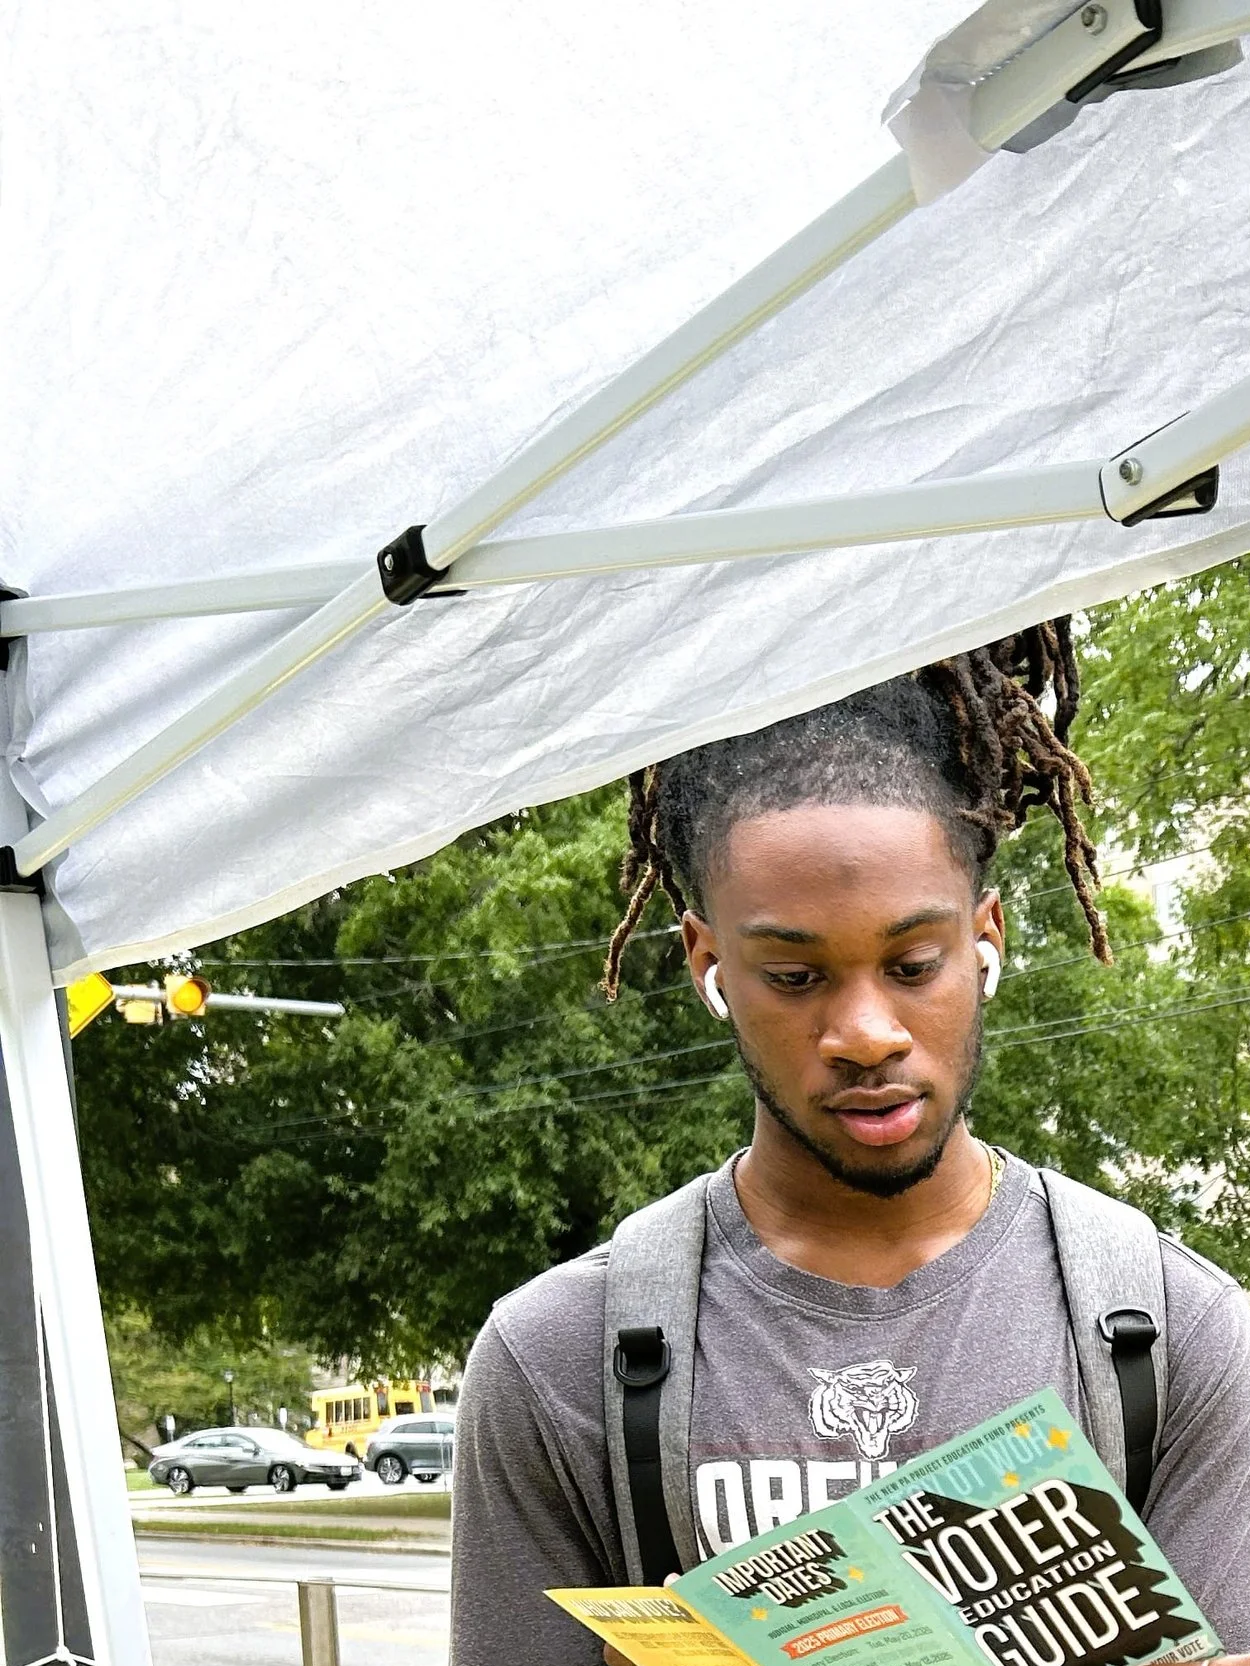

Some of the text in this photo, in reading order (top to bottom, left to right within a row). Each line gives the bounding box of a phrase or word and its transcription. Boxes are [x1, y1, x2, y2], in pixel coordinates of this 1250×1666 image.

[865, 1491, 881, 1505] THE
[882, 1484, 899, 1497] NEW
[899, 1475, 912, 1487] PA
[911, 1460, 943, 1482] PROJECT
[943, 1439, 985, 1464] EDUCATION
[985, 1426, 1006, 1443] FUND
[1006, 1404, 1046, 1432] PRESENTS
[873, 1490, 945, 1545] THE
[901, 1479, 1101, 1605] VOTER
[711, 1528, 833, 1597] IMPORTANT
[758, 1561, 833, 1605] DATES
[958, 1540, 1118, 1626] EDUCATION
[792, 1609, 900, 1655] 2025 PRIMARY ELECTION
[1179, 1638, 1205, 1659] VOTE
